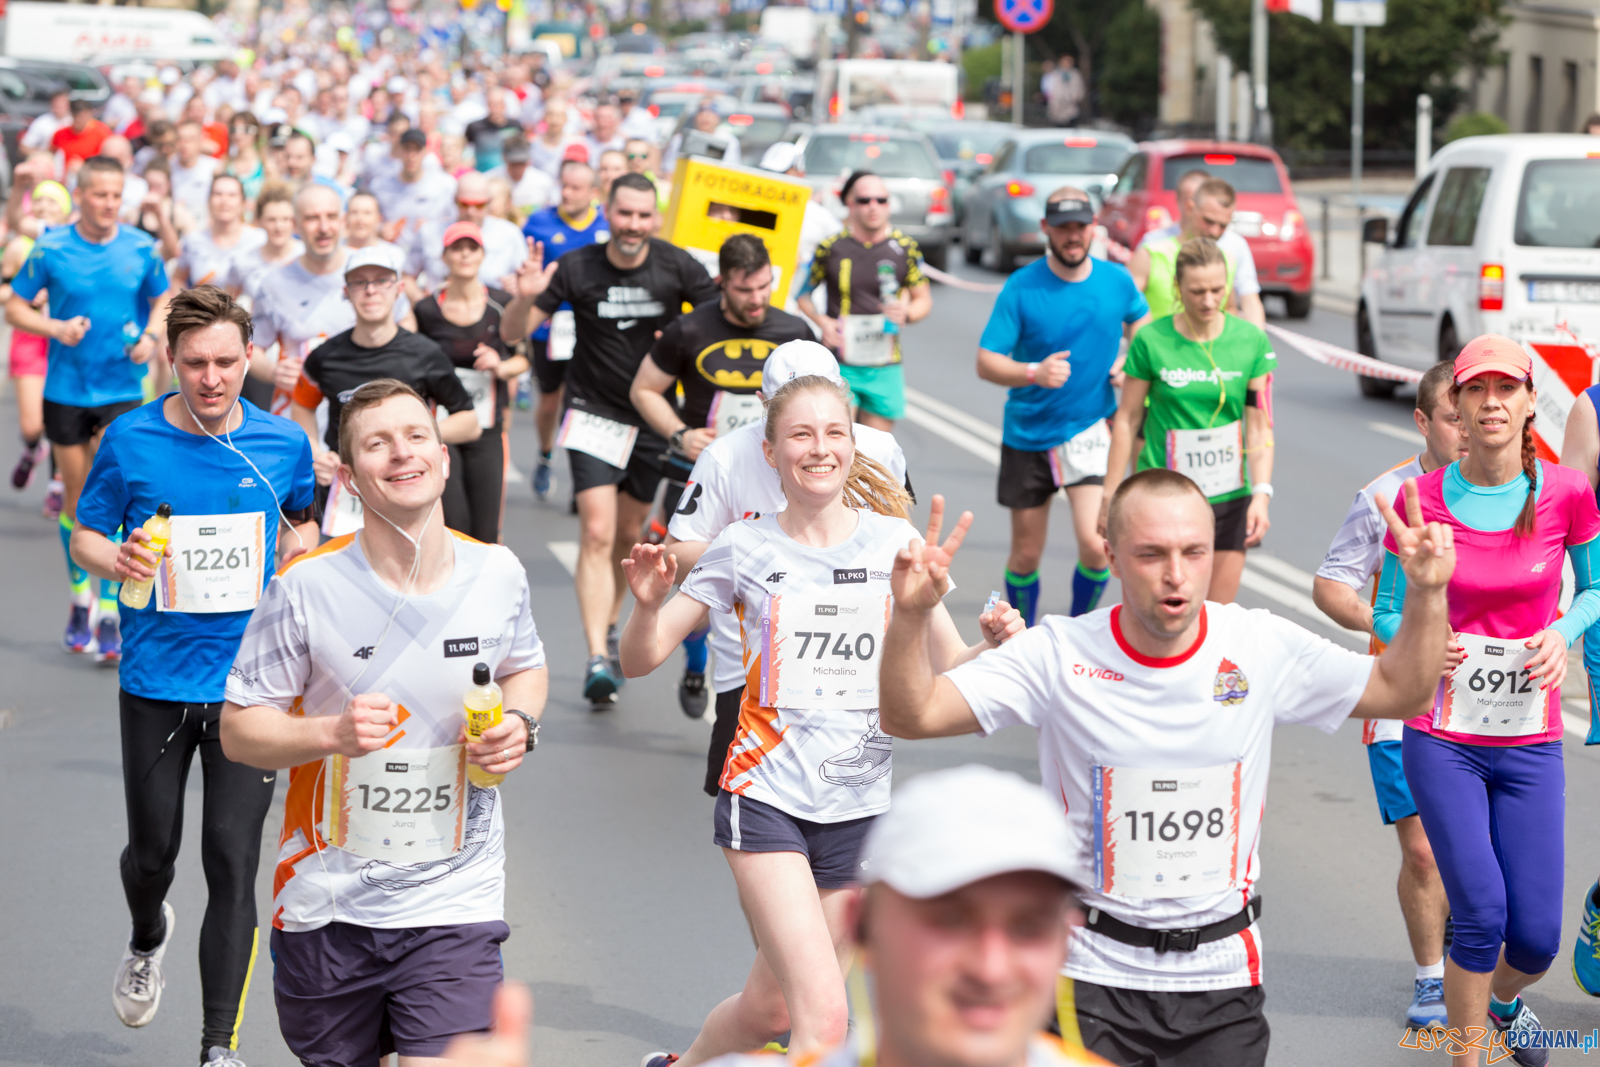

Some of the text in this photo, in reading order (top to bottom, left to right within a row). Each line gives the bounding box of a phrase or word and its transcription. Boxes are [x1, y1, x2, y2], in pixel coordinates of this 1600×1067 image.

[693, 171, 801, 205] FOTORADAR
[1186, 446, 1234, 468] 11015
[182, 546, 250, 571] 12261
[766, 572, 787, 583] 4F
[795, 631, 875, 660] 7740
[813, 667, 857, 676] Michalina
[1468, 668, 1532, 694] 6912
[1477, 698, 1523, 708] Małgorzata
[358, 784, 451, 813] 12225
[392, 820, 416, 829] Juraj
[1125, 807, 1224, 842] 11698
[1157, 850, 1197, 861] Szymon
